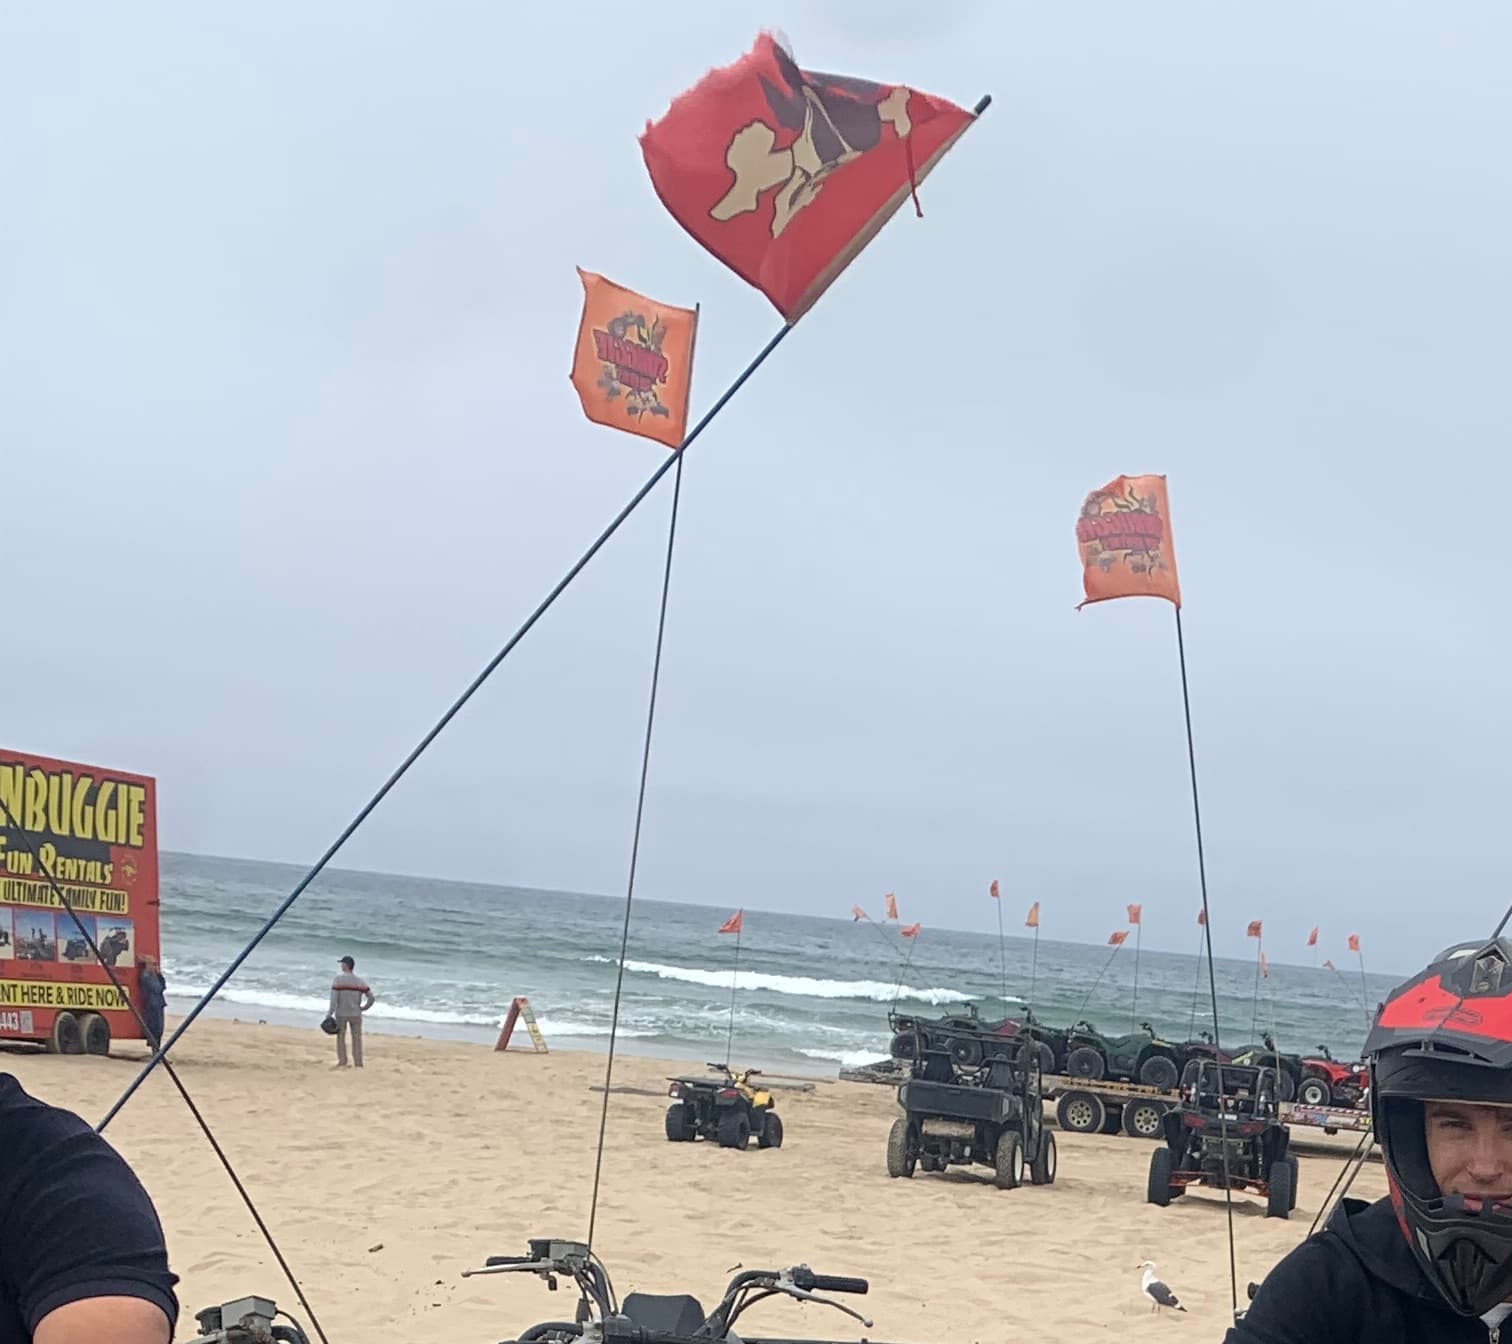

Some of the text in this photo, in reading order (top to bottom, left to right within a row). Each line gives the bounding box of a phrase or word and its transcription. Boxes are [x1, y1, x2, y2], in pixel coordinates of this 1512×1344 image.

[39, 843, 114, 885] RENTALS
[3, 879, 56, 905] ULTIMATE
[100, 890, 126, 912] FUN!
[20, 984, 53, 1004] HERE
[56, 985, 65, 1004] &
[67, 986, 93, 1005] RIDE
